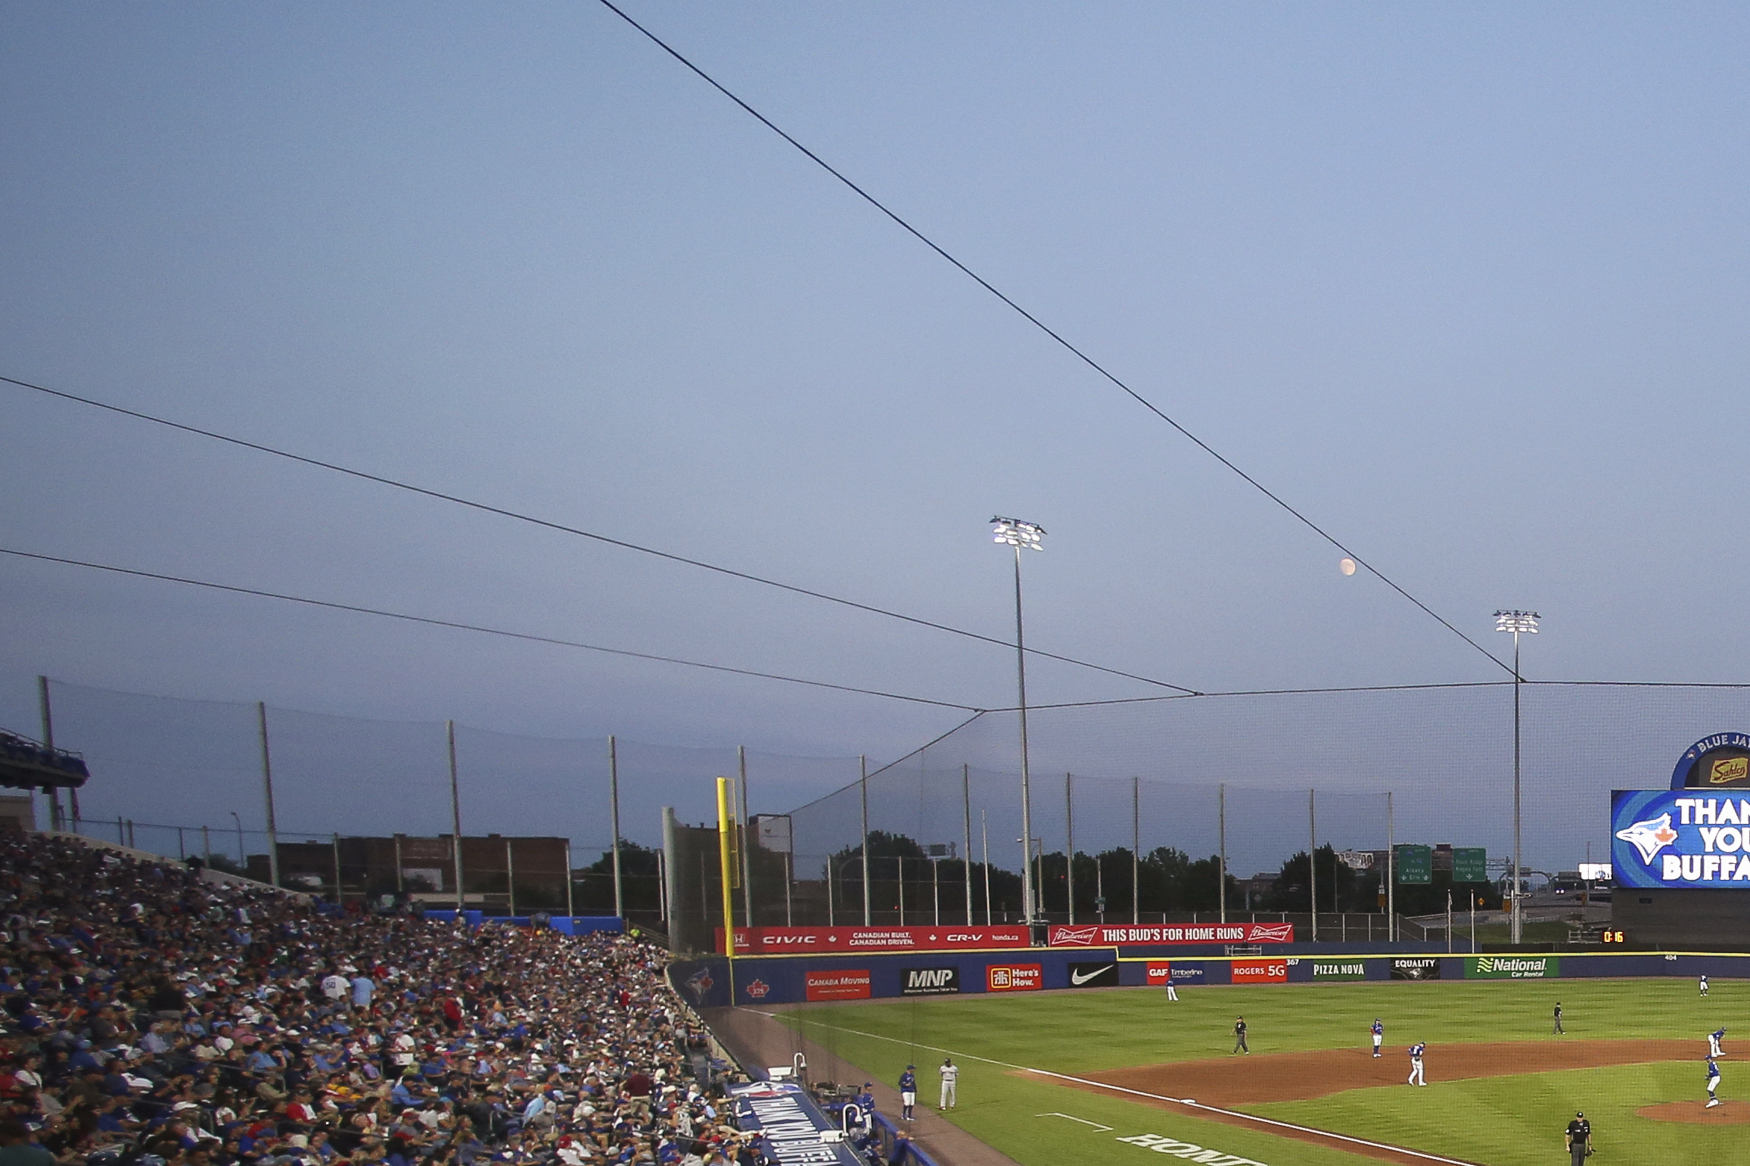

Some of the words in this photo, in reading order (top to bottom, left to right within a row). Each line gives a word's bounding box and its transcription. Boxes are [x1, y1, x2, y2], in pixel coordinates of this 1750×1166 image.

[1697, 734, 1728, 752] BLUE
[946, 934, 983, 942] CR-V
[1102, 929, 1126, 942] THIS
[1128, 928, 1160, 942] BUD'S
[1162, 928, 1183, 941] FOR
[1185, 928, 1215, 940] HOME
[1216, 927, 1244, 940] RUNS
[1604, 932, 1624, 942] 0:16
[762, 936, 816, 944] CIVIC
[849, 938, 886, 946] CANADIAN
[1286, 958, 1300, 966] 367
[1395, 960, 1436, 968] EQUALITY
[1493, 958, 1546, 972] National
[1012, 968, 1039, 977] Here's
[1149, 968, 1168, 976] GAF
[1234, 968, 1265, 976] ROGERS
[1268, 965, 1285, 976] 5G
[1313, 964, 1339, 976] PIZZA
[1341, 964, 1364, 975] NOVA
[908, 970, 953, 988] MNP
[1012, 978, 1034, 986] How.
